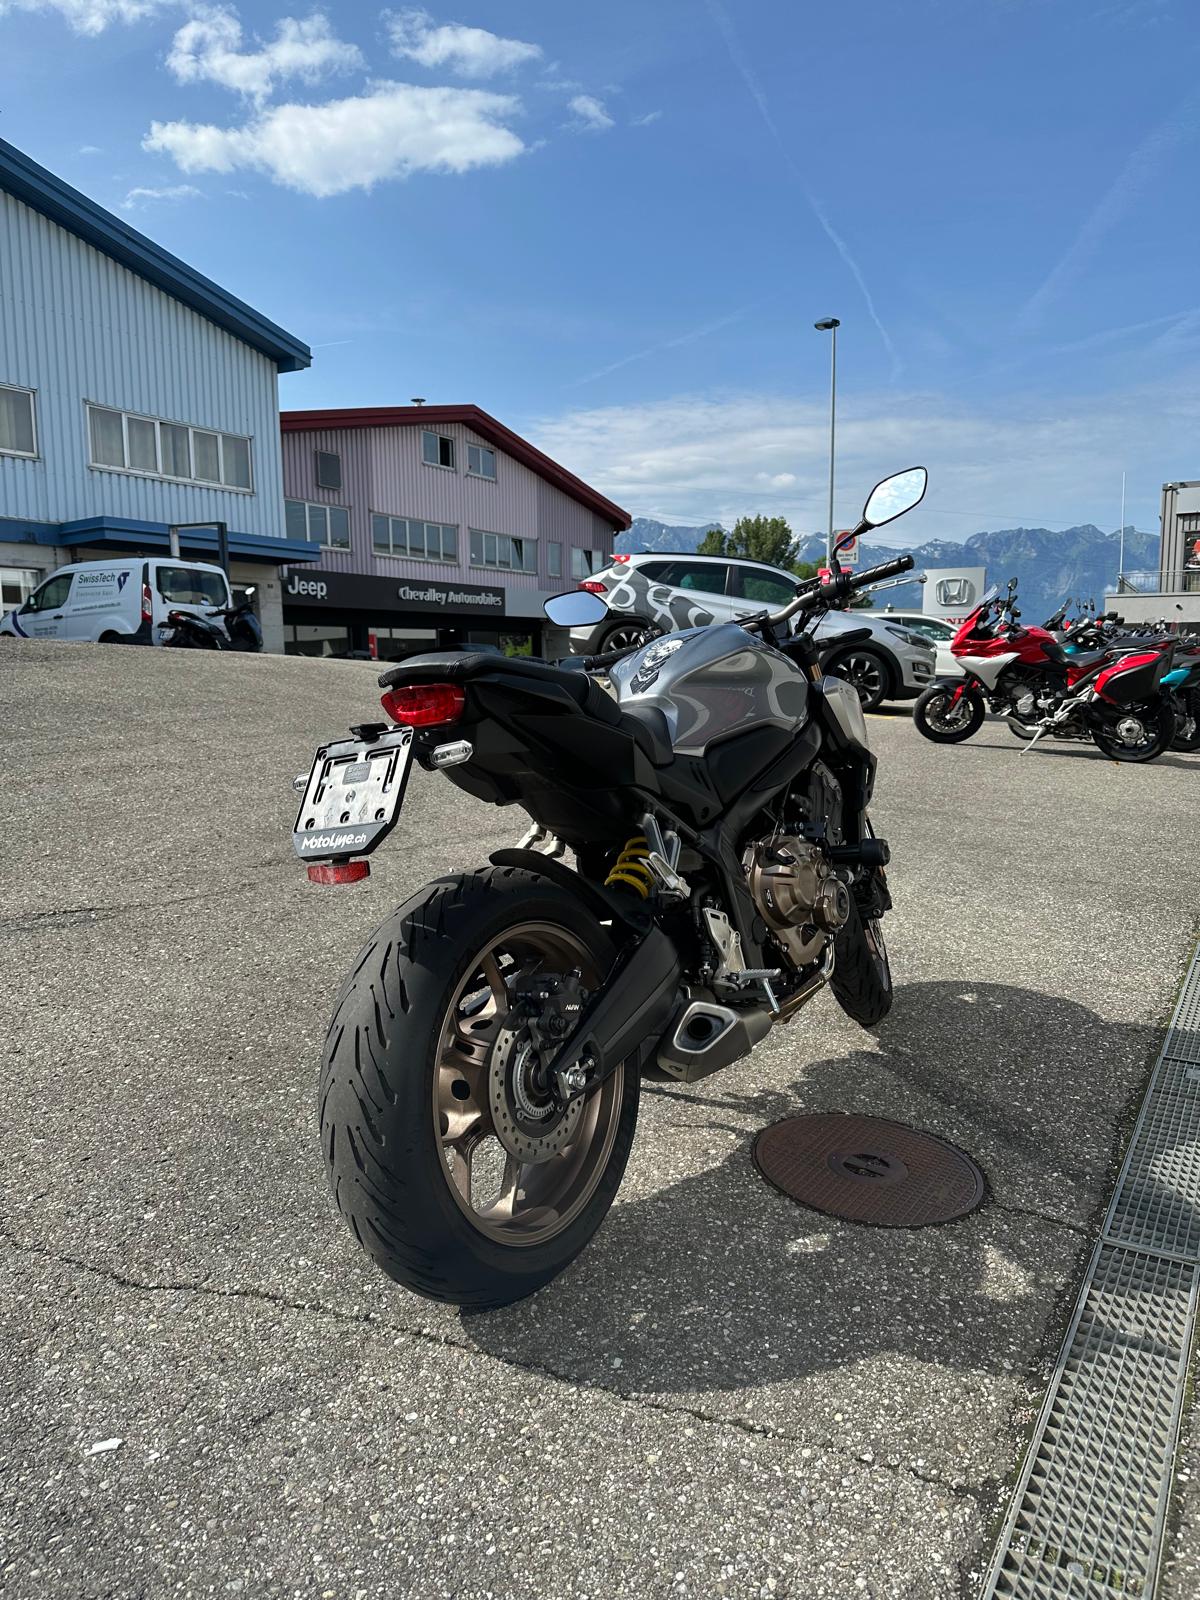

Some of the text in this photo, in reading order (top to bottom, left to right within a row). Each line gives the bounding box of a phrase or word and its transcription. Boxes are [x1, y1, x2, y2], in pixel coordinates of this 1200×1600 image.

[79, 572, 115, 584] SwissTech
[288, 575, 327, 600] Jeep
[399, 586, 502, 606] Chevalley Automobiles
[301, 832, 367, 850] MotoLine.ch
